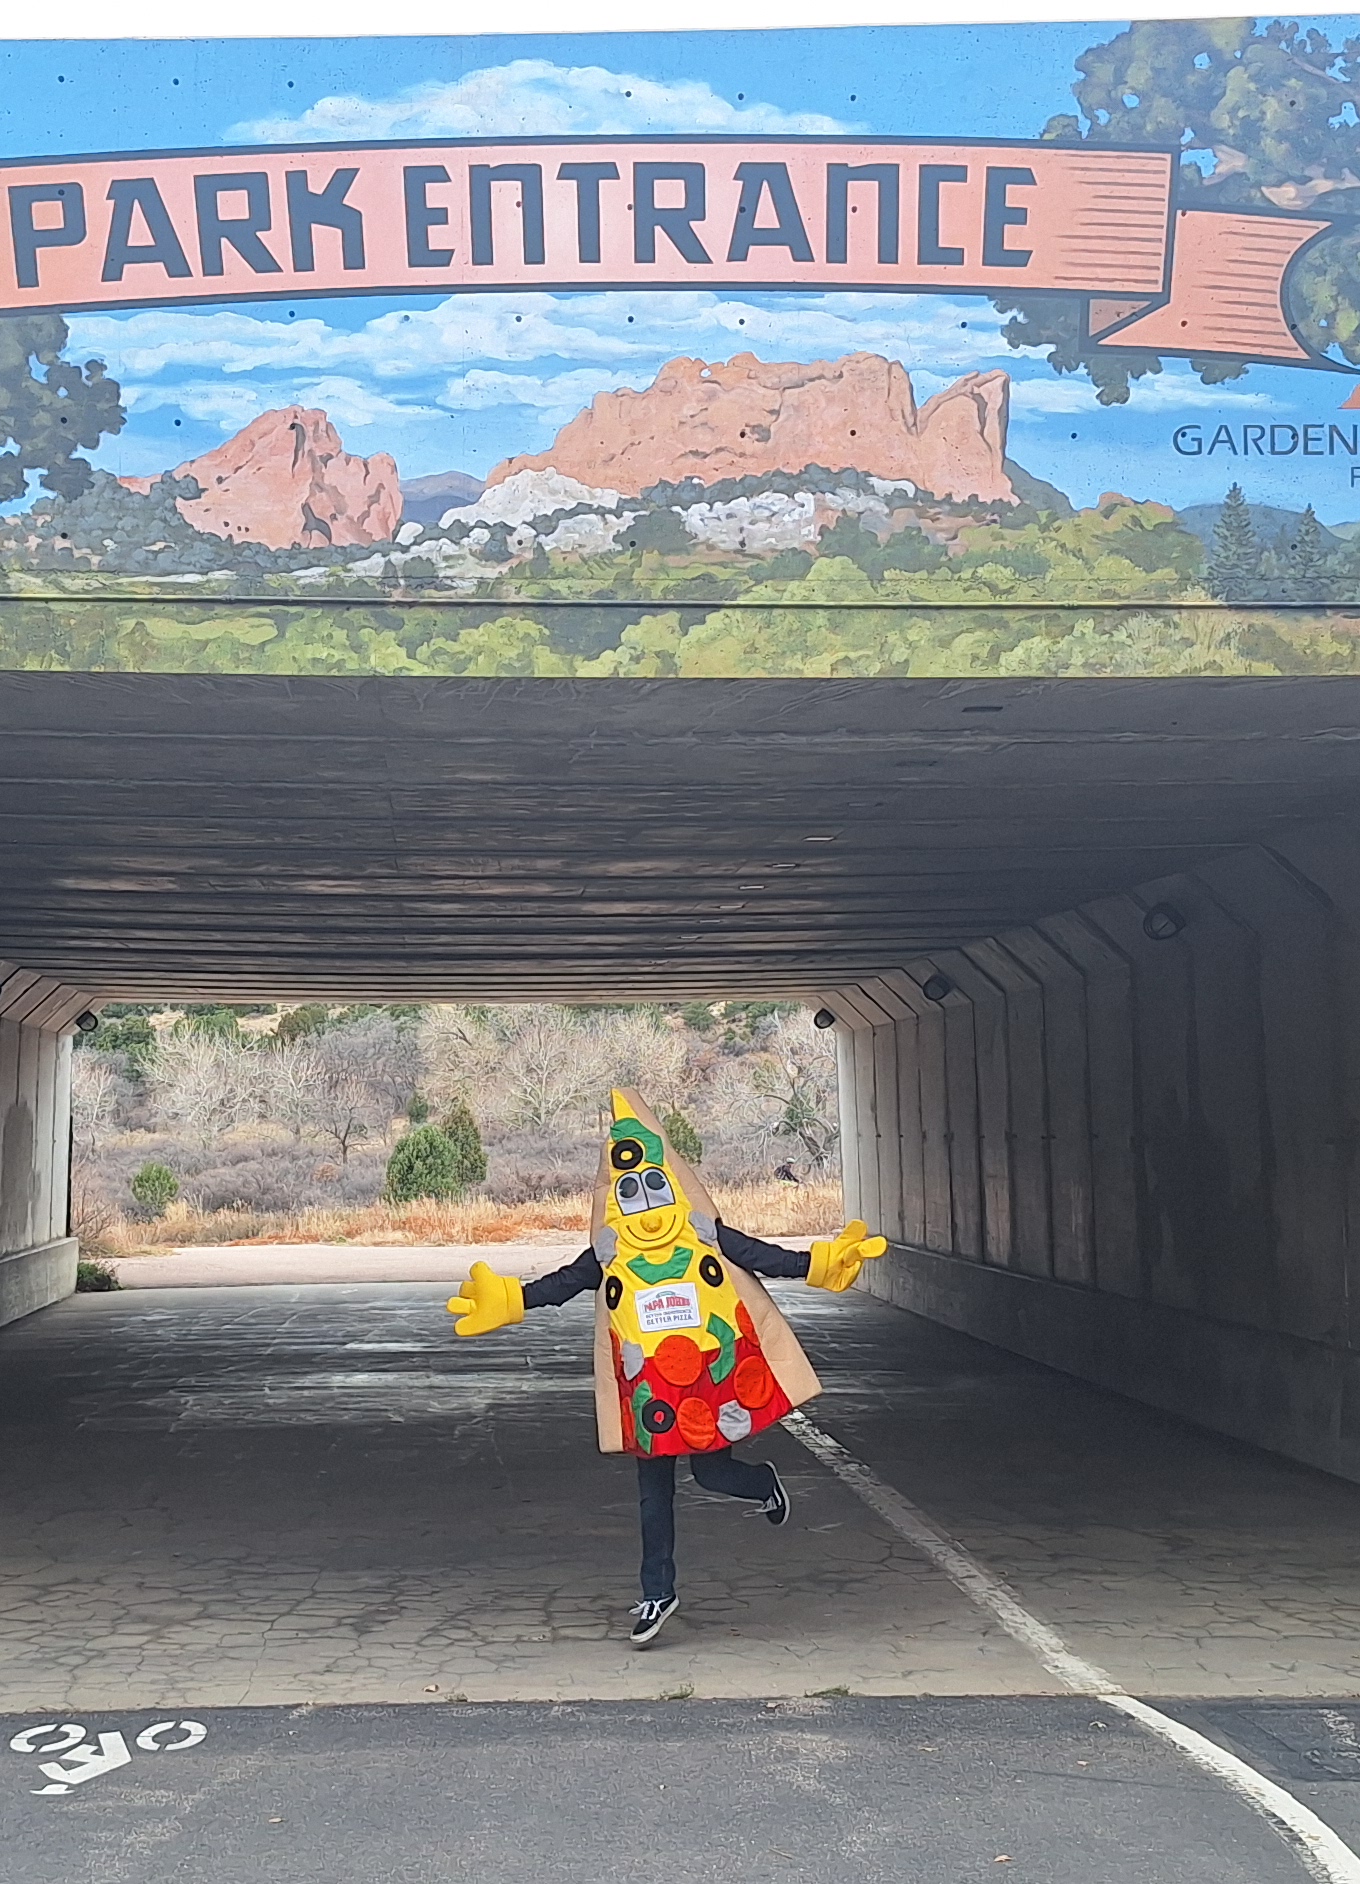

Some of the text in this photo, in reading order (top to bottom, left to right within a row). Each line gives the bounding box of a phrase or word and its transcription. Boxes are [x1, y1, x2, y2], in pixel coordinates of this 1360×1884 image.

[7, 161, 1038, 289] PARK ENTRANCE
[1172, 423, 1358, 456] GARDEN
